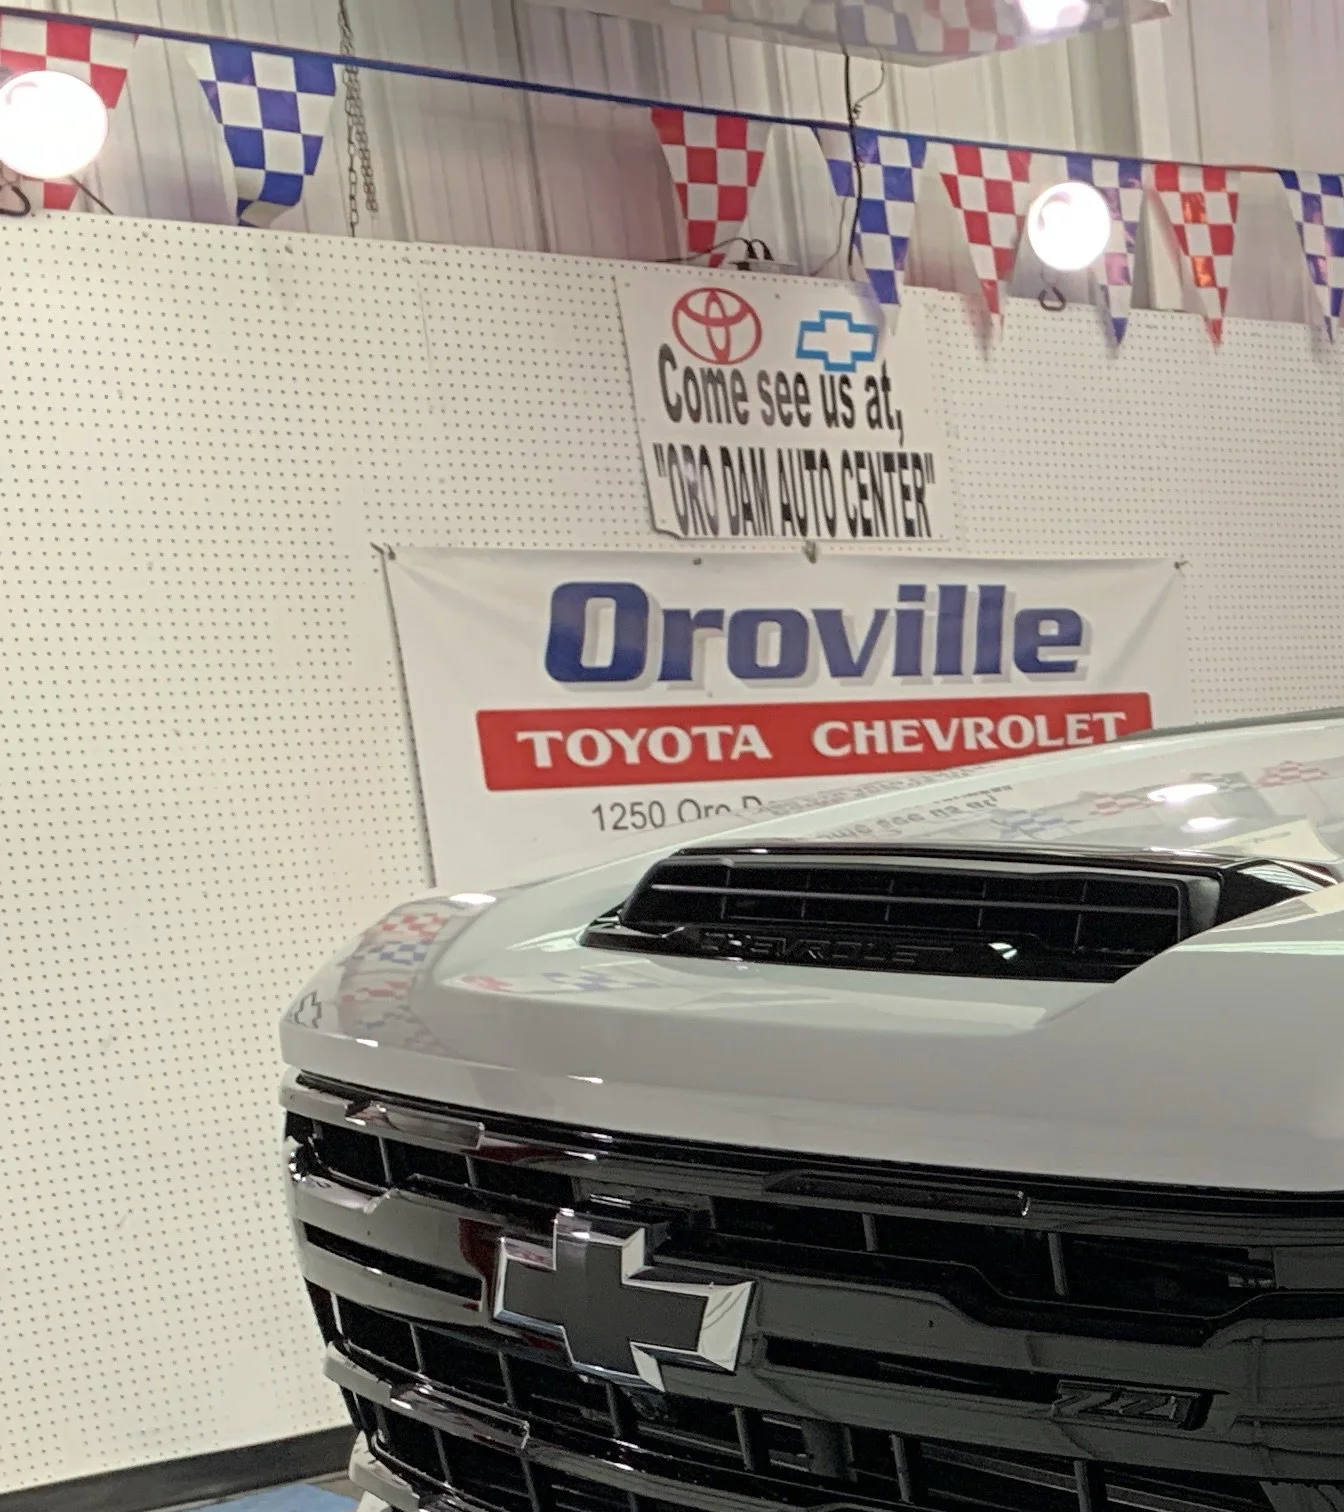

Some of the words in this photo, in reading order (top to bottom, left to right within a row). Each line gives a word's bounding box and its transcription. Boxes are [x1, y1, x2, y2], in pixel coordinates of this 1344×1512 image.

[659, 343, 750, 425] Come
[757, 369, 812, 427] see
[820, 372, 855, 429] us
[864, 359, 904, 447] at,
[653, 443, 719, 536] "ORO
[719, 446, 774, 537] DAM
[777, 448, 836, 538] AUTO
[841, 450, 936, 538] CENTER"
[544, 580, 1087, 684] Oroville
[516, 724, 773, 769] TOYOTA
[812, 711, 1128, 758] CHEVROLET
[592, 800, 666, 832] 1250
